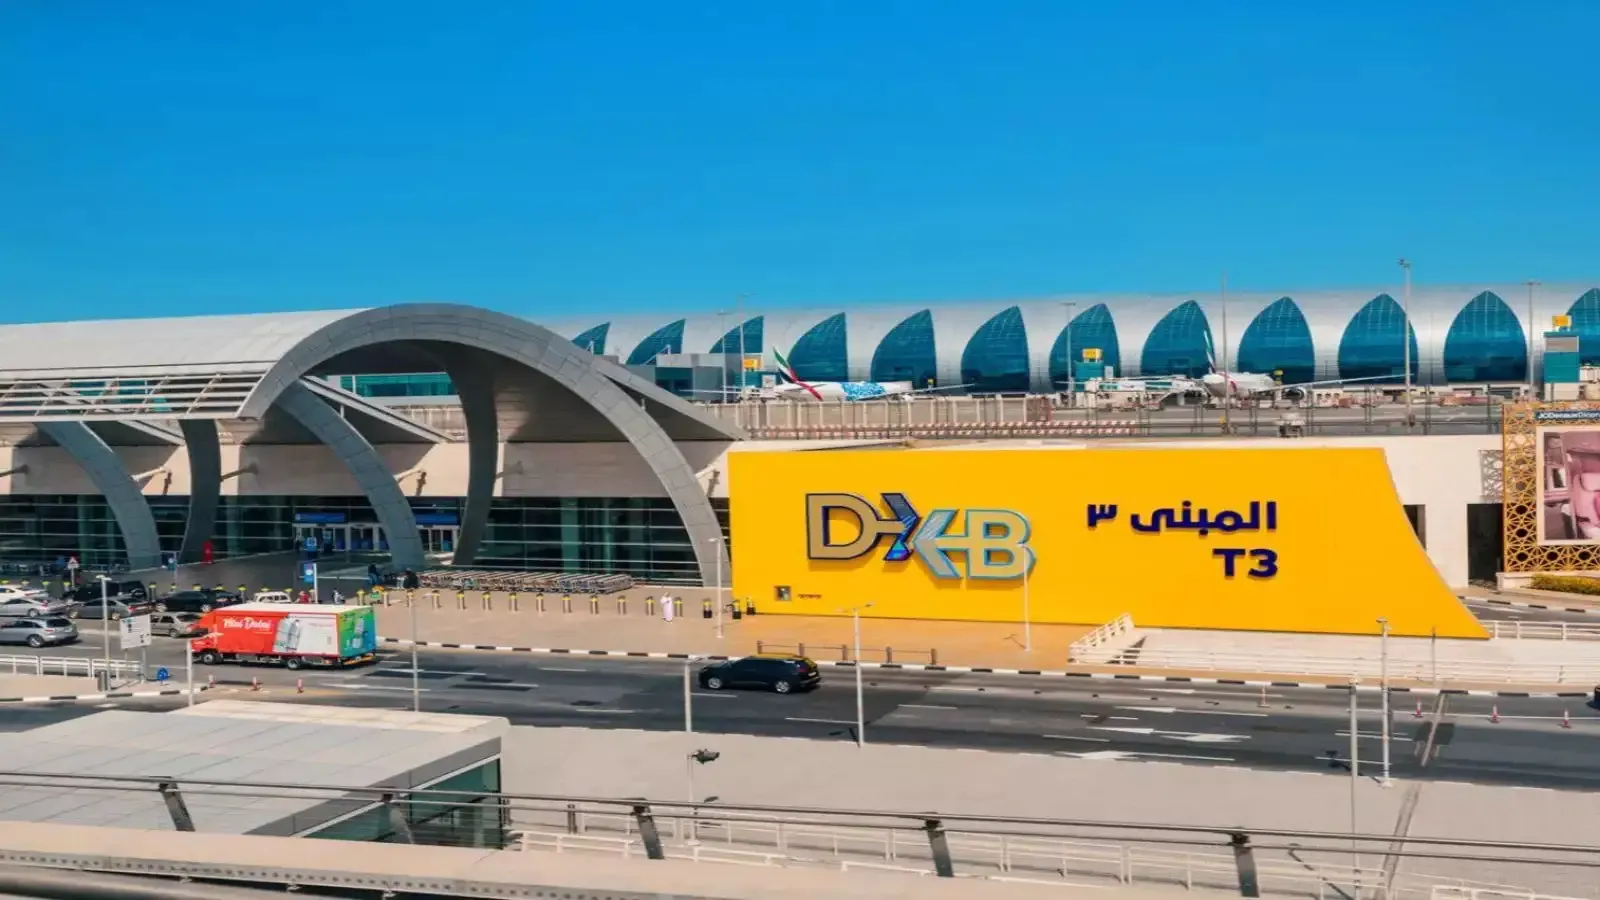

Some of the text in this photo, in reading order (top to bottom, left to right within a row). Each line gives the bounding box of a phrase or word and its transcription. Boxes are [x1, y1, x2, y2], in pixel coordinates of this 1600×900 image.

[805, 493, 1036, 579] DXB
[1087, 501, 1277, 536] المبنى ٣
[1212, 549, 1279, 578] T3
